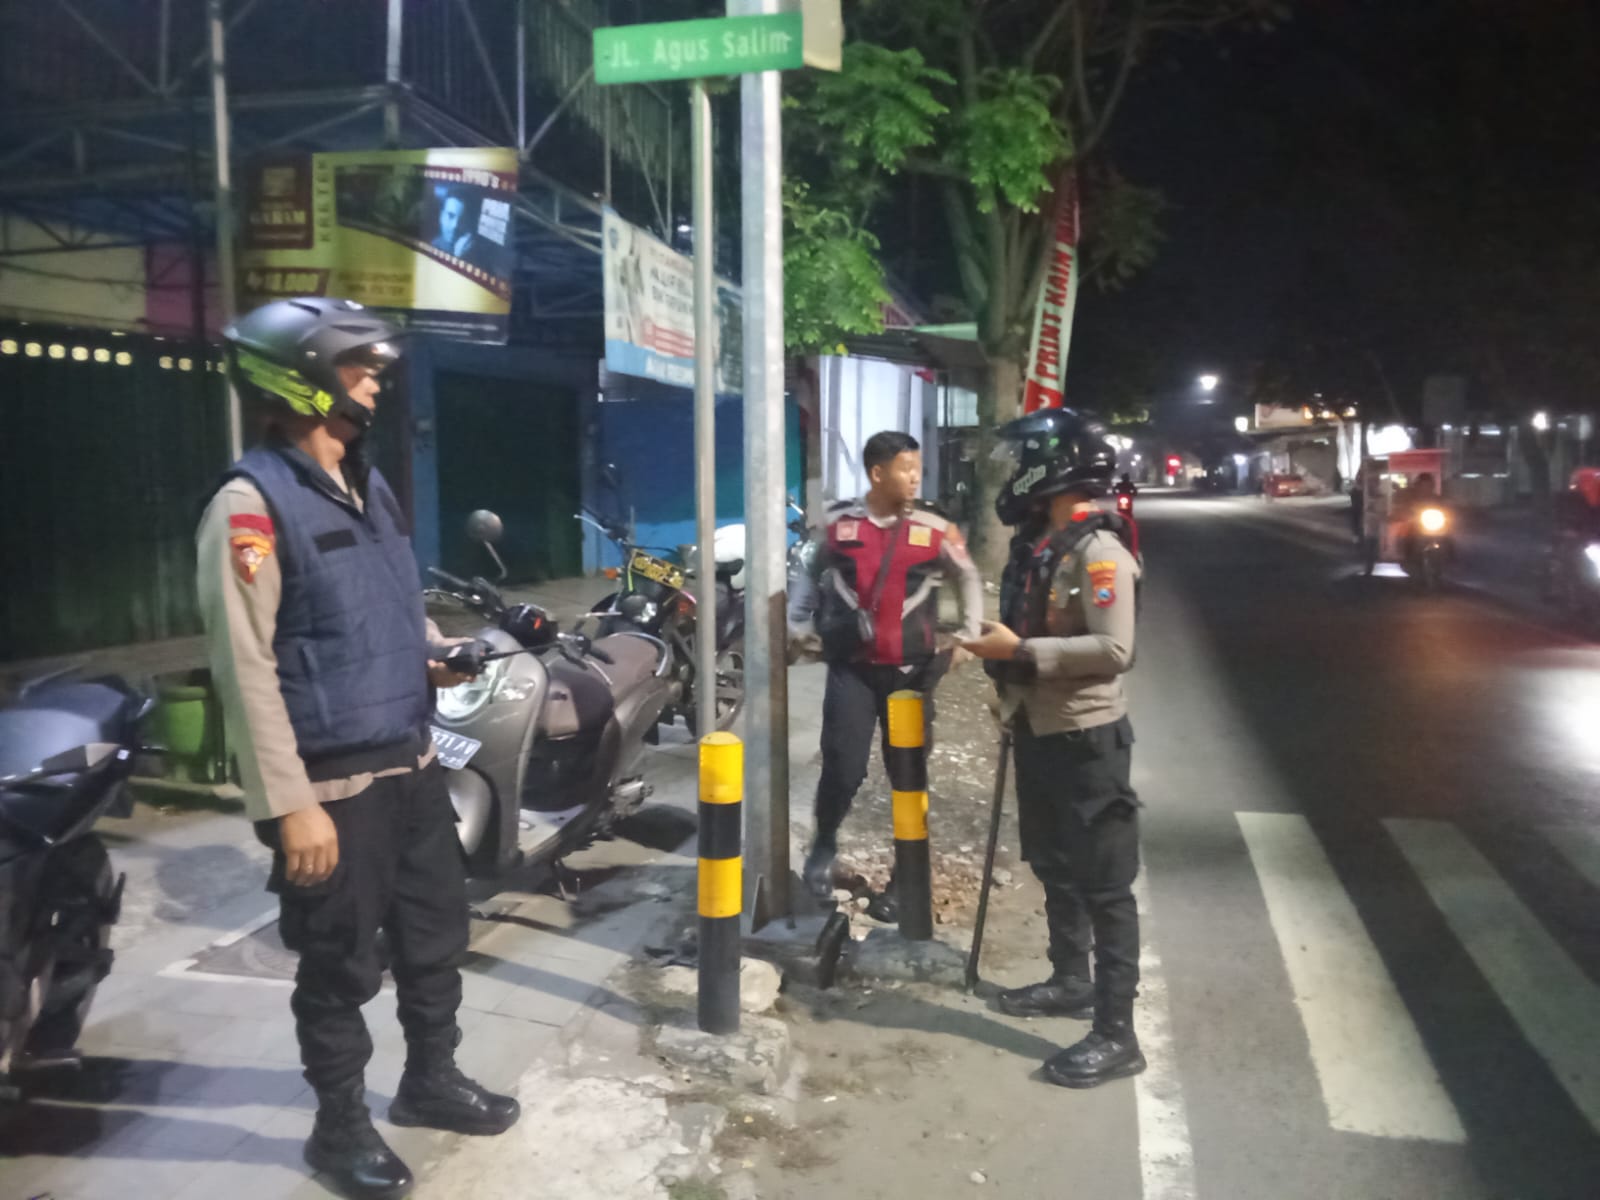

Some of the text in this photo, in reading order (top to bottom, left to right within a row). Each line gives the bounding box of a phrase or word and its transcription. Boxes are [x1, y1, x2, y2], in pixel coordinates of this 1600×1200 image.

[653, 38, 710, 72] Agus
[722, 27, 791, 60] Salim
[1044, 249, 1073, 308] KAIN
[1034, 308, 1063, 381] PRINT
